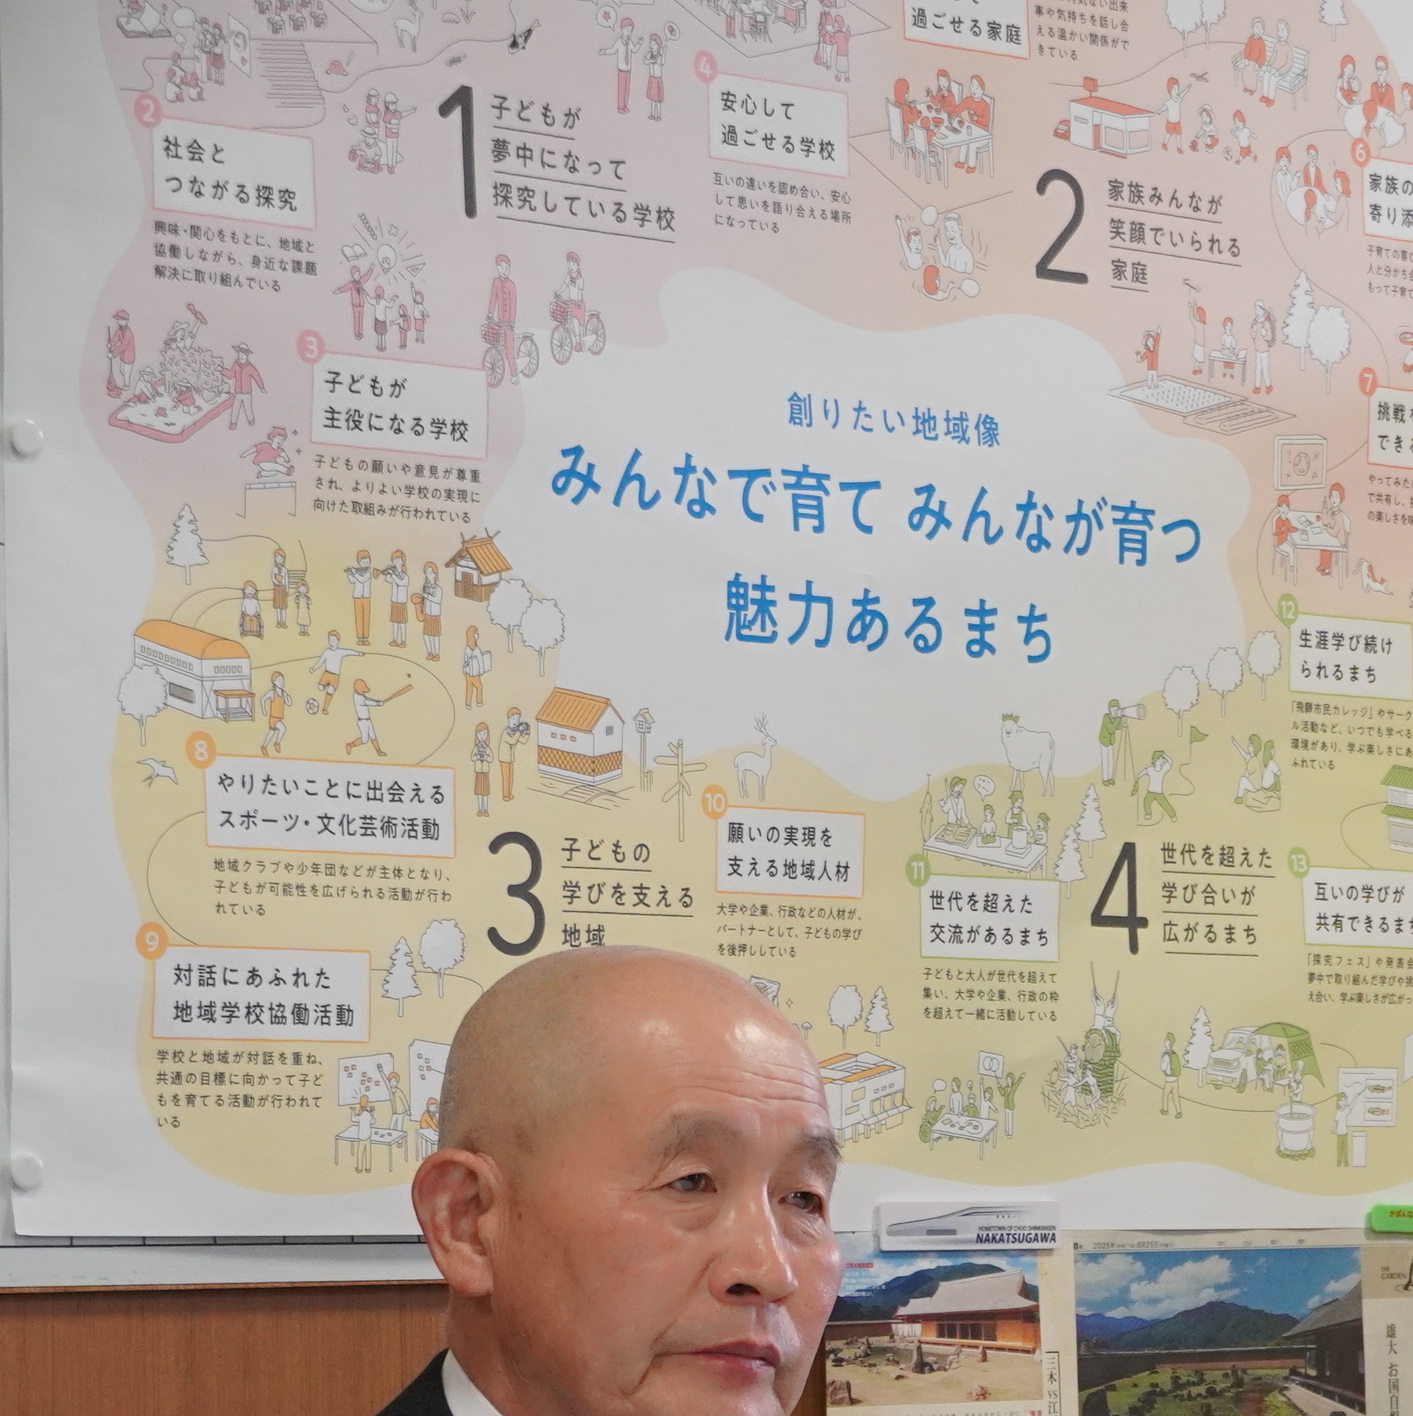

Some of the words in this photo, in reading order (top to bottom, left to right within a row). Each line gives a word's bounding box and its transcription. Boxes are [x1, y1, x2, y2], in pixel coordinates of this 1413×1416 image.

[911, 7, 1023, 46] 過ごせる家庭
[1035, 5, 1129, 33] 事や気持ちを話し合
[1036, 25, 1130, 51] える温かい関係がで
[1038, 44, 1078, 61] きている
[700, 59, 712, 78] 4
[143, 101, 154, 120] 2
[491, 95, 582, 131] 子どもが
[721, 91, 795, 120] 安心して
[163, 135, 226, 165] 社会と
[438, 85, 478, 220] 1
[721, 125, 836, 162] 過ごせる学校
[1356, 144, 1365, 161] 6
[491, 138, 627, 181] 夢中になって
[165, 175, 298, 213] つながる探究
[713, 172, 851, 205] 互いの違いを認め合い、安心
[1107, 178, 1223, 216] 家族みんなが
[492, 182, 676, 233] 探究している学校
[715, 194, 852, 225] して思いを語り合える場所
[154, 221, 316, 255] 興味・関心をもとに、地域と
[715, 215, 780, 234] になっている
[1036, 169, 1089, 285] 2
[1109, 217, 1242, 259] 笑顔でいられる
[154, 244, 317, 277] 協働しながら、身近な課題
[1111, 258, 1148, 286] 家庭
[154, 265, 281, 293] 解決に取り組んでいる
[305, 337, 317, 359] 3
[324, 371, 408, 400] 子どもが
[1363, 374, 1373, 393] 7
[323, 407, 470, 443] 主役になる学校
[788, 391, 1001, 448] 創りたい地域像
[314, 454, 482, 484] 子どもの願いや意見が尊重
[315, 477, 481, 504] され、よりよい学校の実現に
[313, 499, 472, 524] 向けた取組みが行われている
[550, 444, 883, 536] みんなで育て
[907, 482, 1203, 568] みんなが育つ
[724, 572, 1054, 665] 魅力あるまち
[1280, 601, 1296, 620] 12
[1299, 629, 1393, 655] 生涯学び続け
[1301, 660, 1378, 685] られるまち
[195, 740, 208, 762] 8
[1291, 758, 1336, 771] ふれている
[217, 773, 446, 806] やりたいことに出会える
[705, 792, 726, 811] 10
[218, 808, 441, 841] スポーツ・文化芸術活動
[728, 822, 833, 849] 願いの実現を
[562, 837, 651, 865] 子どもの
[1160, 841, 1274, 869] 世代を超えた
[1291, 854, 1306, 872] 13
[727, 856, 851, 884] 支える地域人材
[911, 860, 925, 881] 11
[214, 879, 452, 904] 子どもが可能性を広げられる活動が行わ
[487, 831, 546, 957] 3
[562, 879, 695, 909] 学びを支える
[929, 890, 1034, 916] 世代を超えた
[1090, 841, 1149, 956] 4
[1161, 881, 1256, 908] 学び合いが
[1314, 882, 1406, 904] 互いの学びが
[215, 902, 266, 917] れている
[146, 931, 160, 952] 9
[562, 924, 606, 948] 地域
[929, 922, 1050, 948] 交流があるまち
[1162, 920, 1258, 946] 広がるまち
[717, 942, 797, 959] を後押ししている
[173, 963, 332, 990] 対話にあふれた
[172, 1000, 355, 1027] 地域学校協働活動
[156, 1049, 324, 1067] 学校と地域が対話を重ね、
[156, 1071, 324, 1088] 共通の目標に向かって子ど
[157, 1093, 324, 1110] もを育てる活動が行われて
[157, 1115, 182, 1129] いる
[975, 1232, 1057, 1244] NAKATSUGAWA
